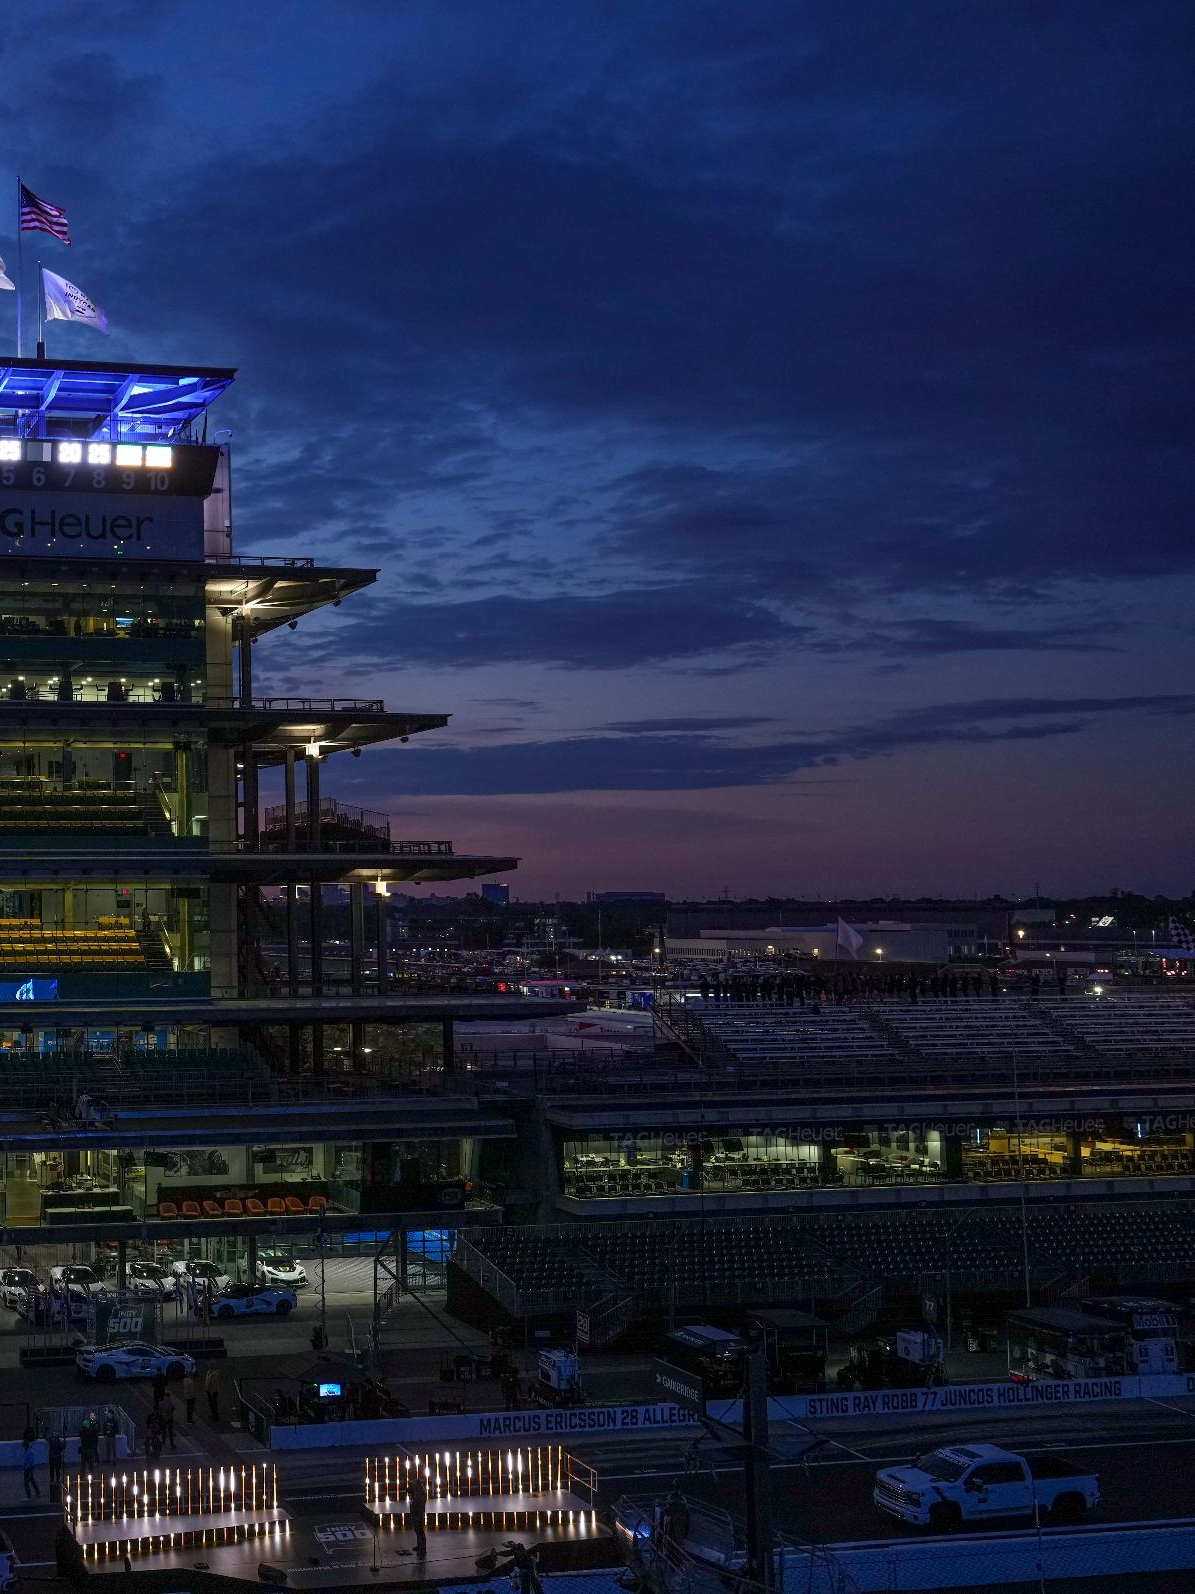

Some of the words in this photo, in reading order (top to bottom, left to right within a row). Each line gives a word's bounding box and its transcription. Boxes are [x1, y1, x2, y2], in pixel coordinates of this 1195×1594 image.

[3, 466, 15, 485] 5
[32, 467, 45, 486] 6
[63, 468, 75, 487] 7
[92, 469, 105, 488] 8
[122, 471, 135, 490] 9
[148, 472, 169, 490] 10
[108, 1318, 143, 1333] 500
[662, 1375, 700, 1402] GAINBRIDGE
[809, 1398, 848, 1415] STING
[854, 1395, 878, 1412] RAY
[882, 1393, 917, 1411] ROBB
[921, 1391, 937, 1408] 77
[941, 1388, 994, 1407] JUNCOS
[997, 1383, 1070, 1404] HOLLINGER
[1074, 1381, 1122, 1399] RACING
[479, 1416, 541, 1435] MARCUS
[545, 1409, 617, 1431] ERICSSON
[621, 1408, 638, 1426] 28
[317, 1529, 374, 1542] 500
